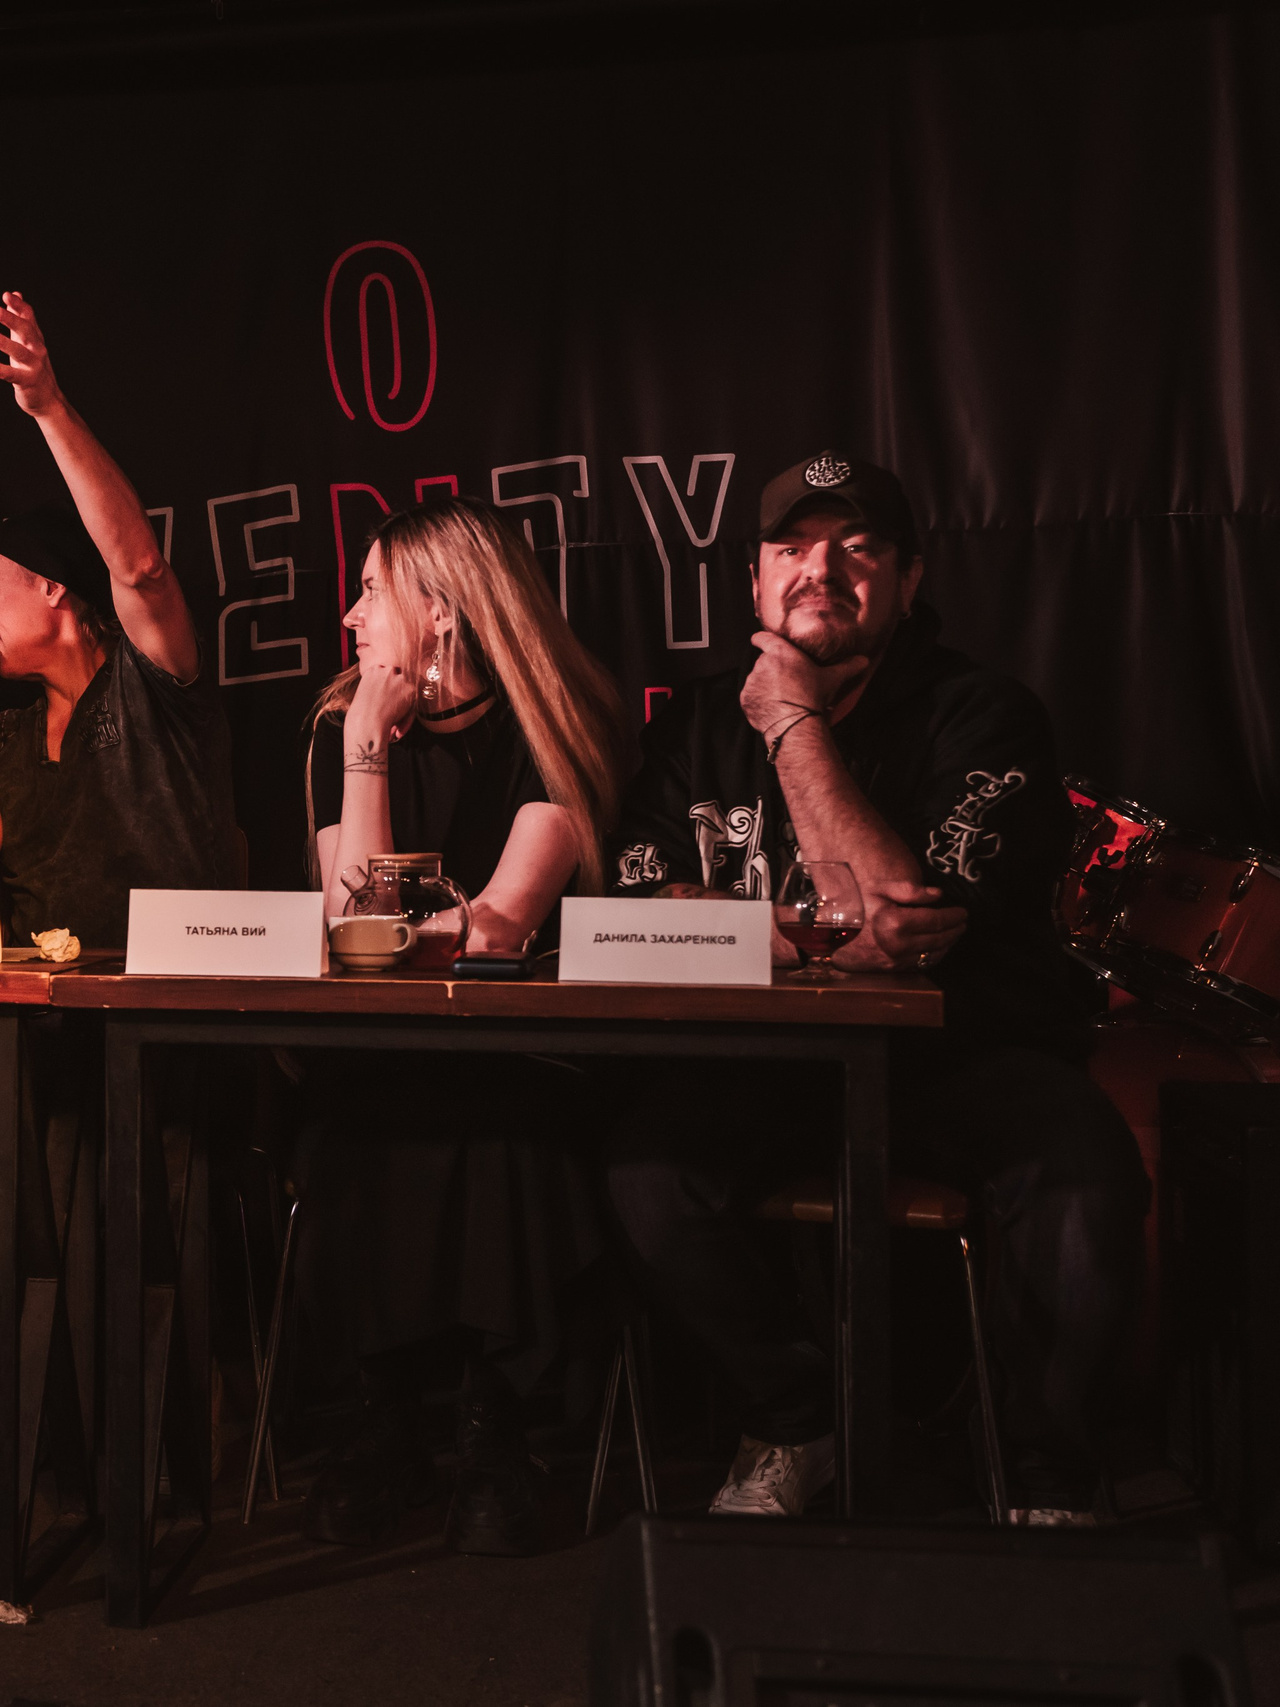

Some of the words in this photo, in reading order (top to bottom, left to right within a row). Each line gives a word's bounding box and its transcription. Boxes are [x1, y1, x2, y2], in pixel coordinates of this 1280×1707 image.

[185, 925, 238, 936] ТАТЬЯНА
[241, 925, 267, 937] ВИЙ
[593, 932, 647, 944] ДАНИЛА
[650, 933, 737, 946] ЗАХАРЕНКОВ
